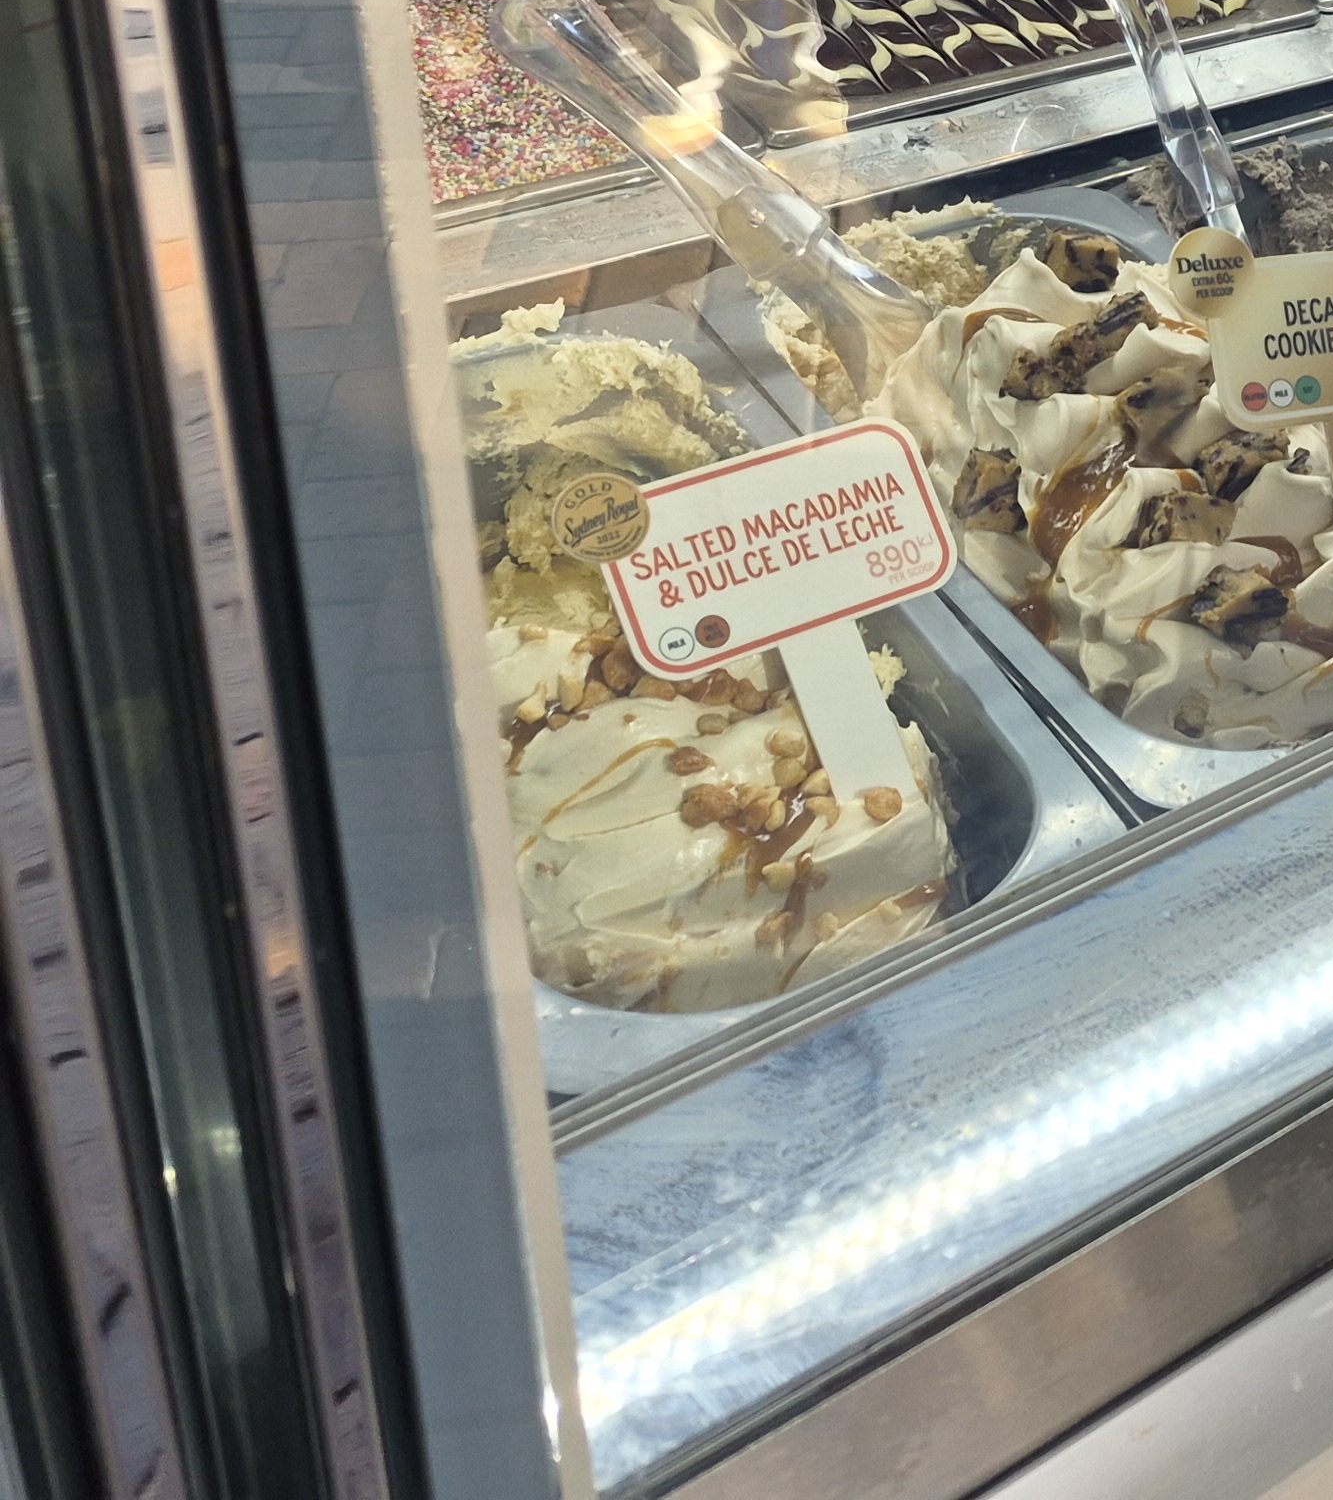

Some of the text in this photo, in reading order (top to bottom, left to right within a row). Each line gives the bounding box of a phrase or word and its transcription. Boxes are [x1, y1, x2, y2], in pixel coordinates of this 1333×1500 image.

[1176, 253, 1244, 274] Deluxe
[564, 481, 612, 509] GOLD
[630, 472, 905, 581] SALTED MACADAMIA
[658, 505, 905, 608] & DULCE DE LECHE
[888, 560, 937, 586] PER SCOOP
[667, 637, 687, 652] MILK
